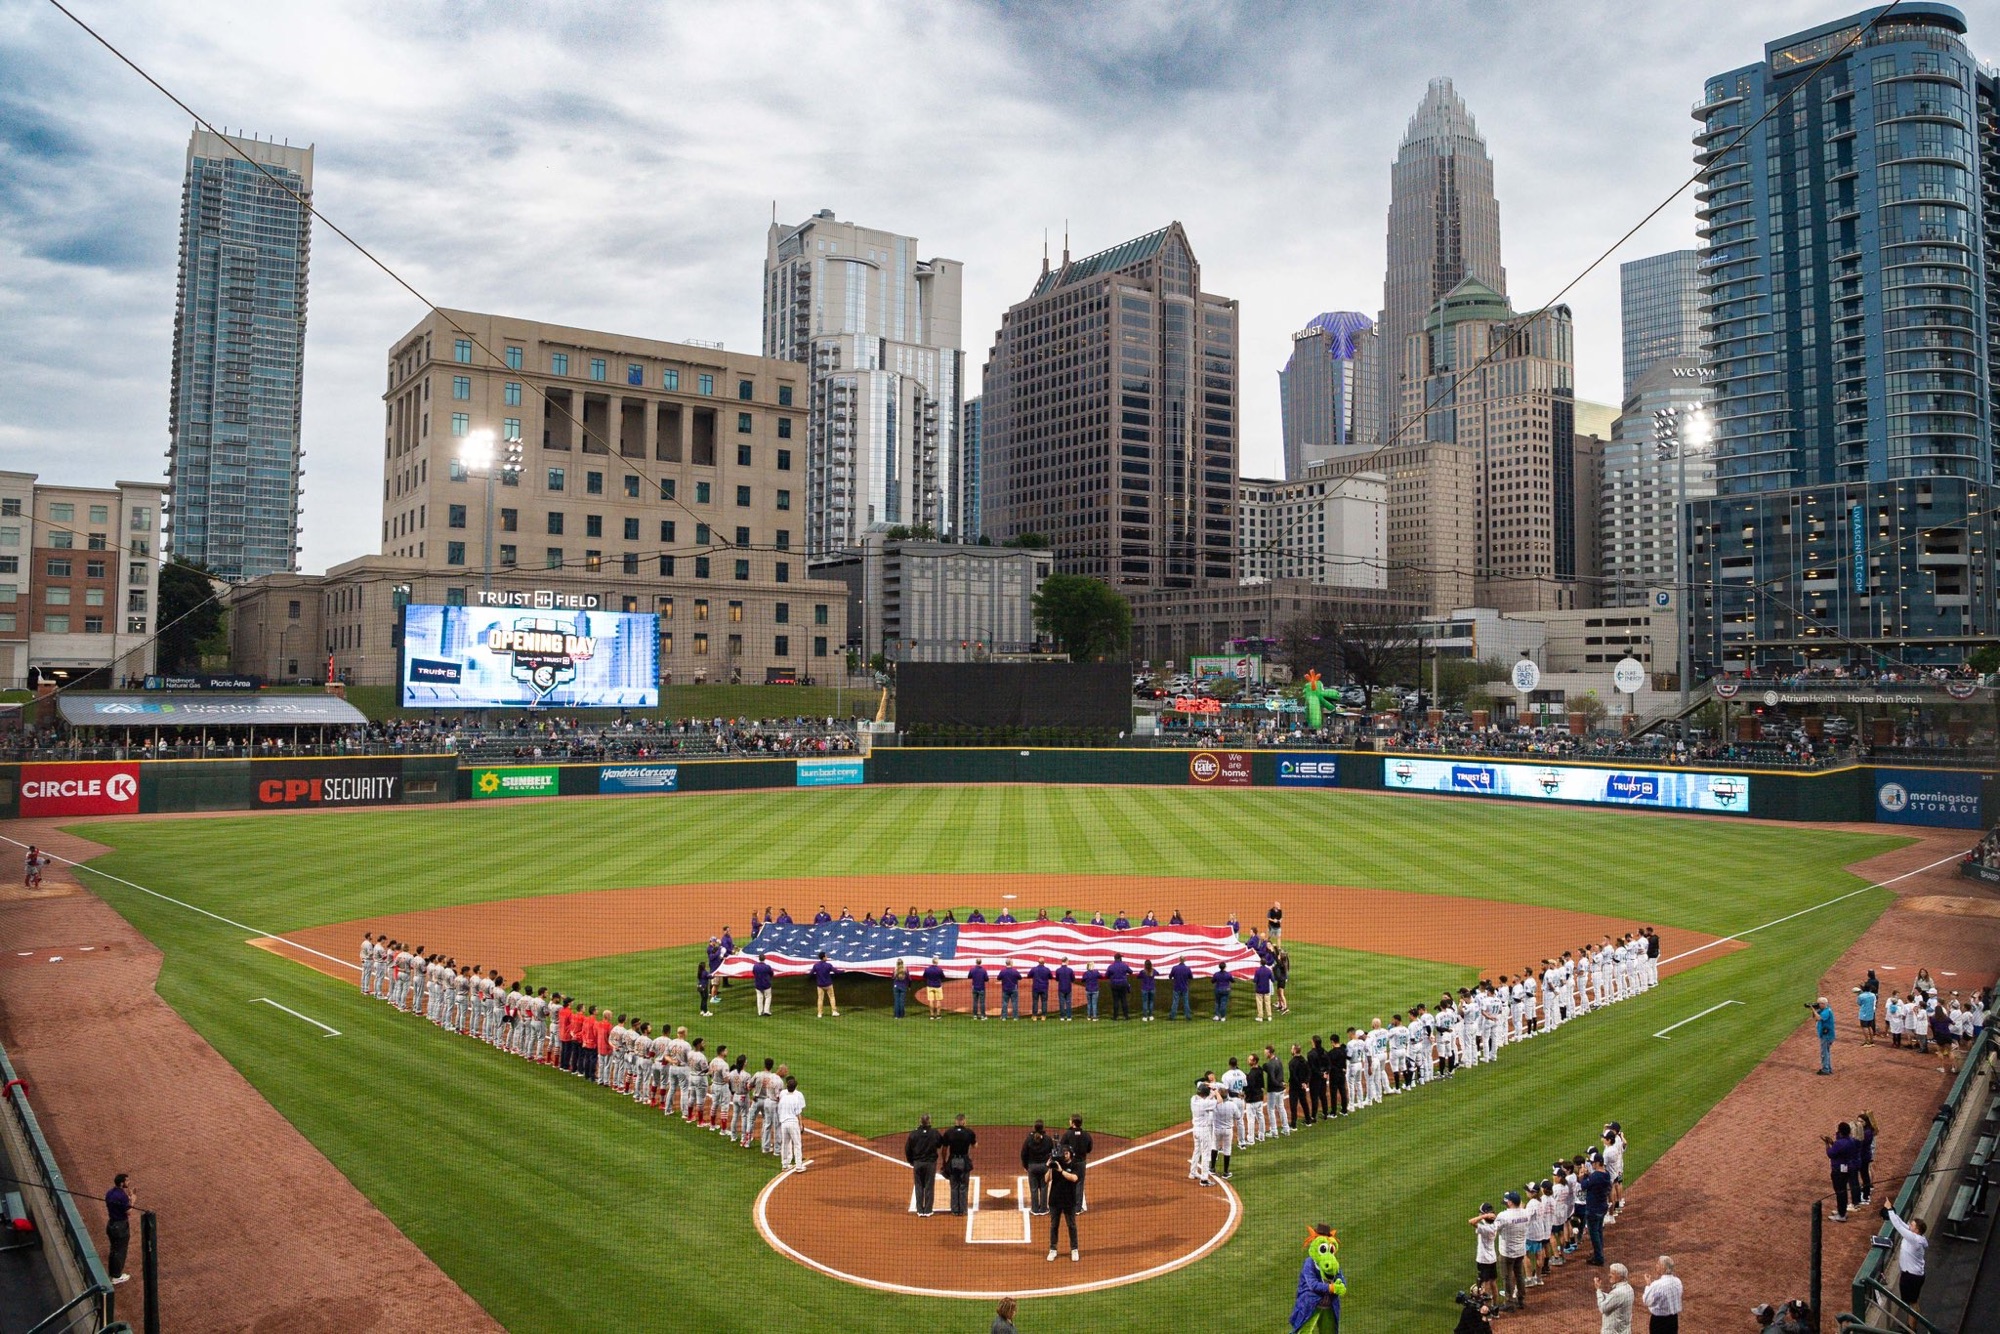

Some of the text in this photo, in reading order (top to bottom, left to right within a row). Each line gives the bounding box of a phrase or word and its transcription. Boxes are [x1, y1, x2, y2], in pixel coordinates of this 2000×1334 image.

[1292, 325, 1322, 341] TRUIST
[478, 591, 598, 608] TRUIST FIELD
[1658, 593, 1667, 604] P
[488, 630, 598, 656] OPENING DAY
[418, 667, 447, 676] TRUIST
[1847, 694, 1922, 704] Home Run Porch
[1228, 753, 1243, 761] We
[1194, 760, 1217, 772] tate
[819, 767, 837, 776] boot
[837, 769, 858, 778] camp
[1456, 772, 1480, 781] TRUIST
[502, 775, 553, 787] SUNBELT
[1613, 782, 1641, 791] TRUIST
[22, 775, 137, 801] CIRCLE K
[259, 776, 394, 803] CPI SECURITY
[1910, 791, 1979, 805] morningstar
[1911, 802, 1978, 814] STORAGE
